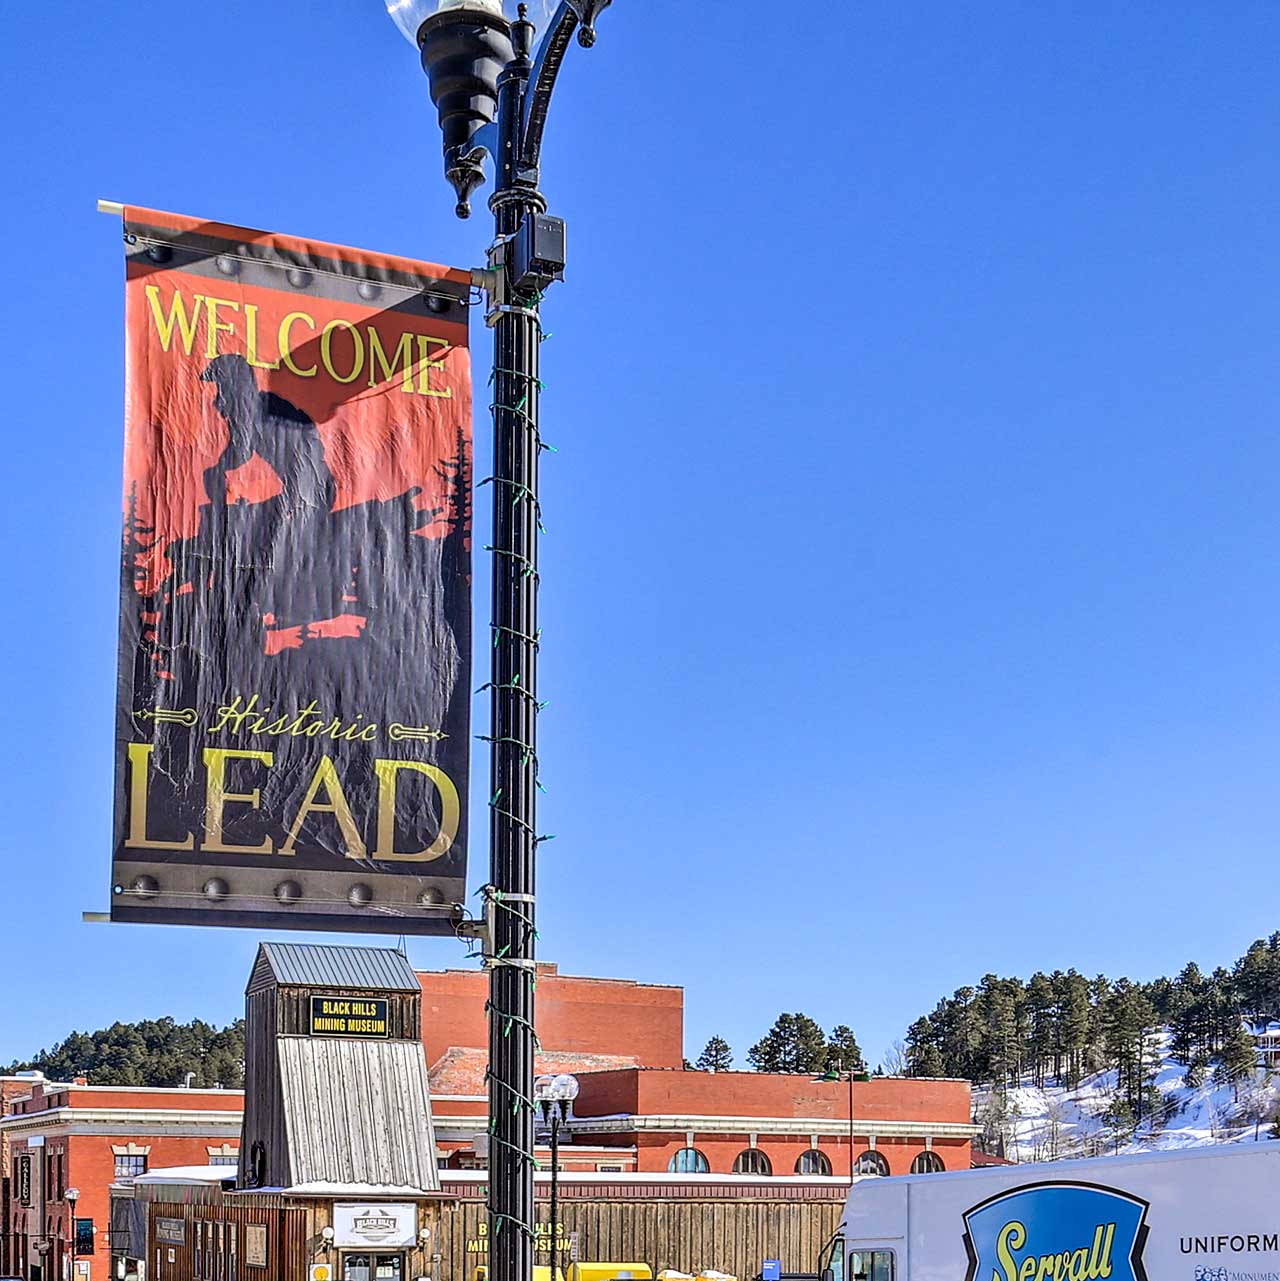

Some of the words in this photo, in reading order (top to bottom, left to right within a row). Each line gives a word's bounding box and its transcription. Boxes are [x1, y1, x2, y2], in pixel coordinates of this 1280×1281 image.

[145, 285, 452, 399] WELCOME
[207, 694, 378, 742] Historic
[124, 742, 461, 863] LEAD
[314, 1017, 346, 1031] MINING
[348, 1019, 385, 1033] MUSEUM
[322, 1001, 350, 1015] BLACK
[352, 1003, 377, 1016] HILLS
[1179, 1234, 1279, 1254] UNIFORM
